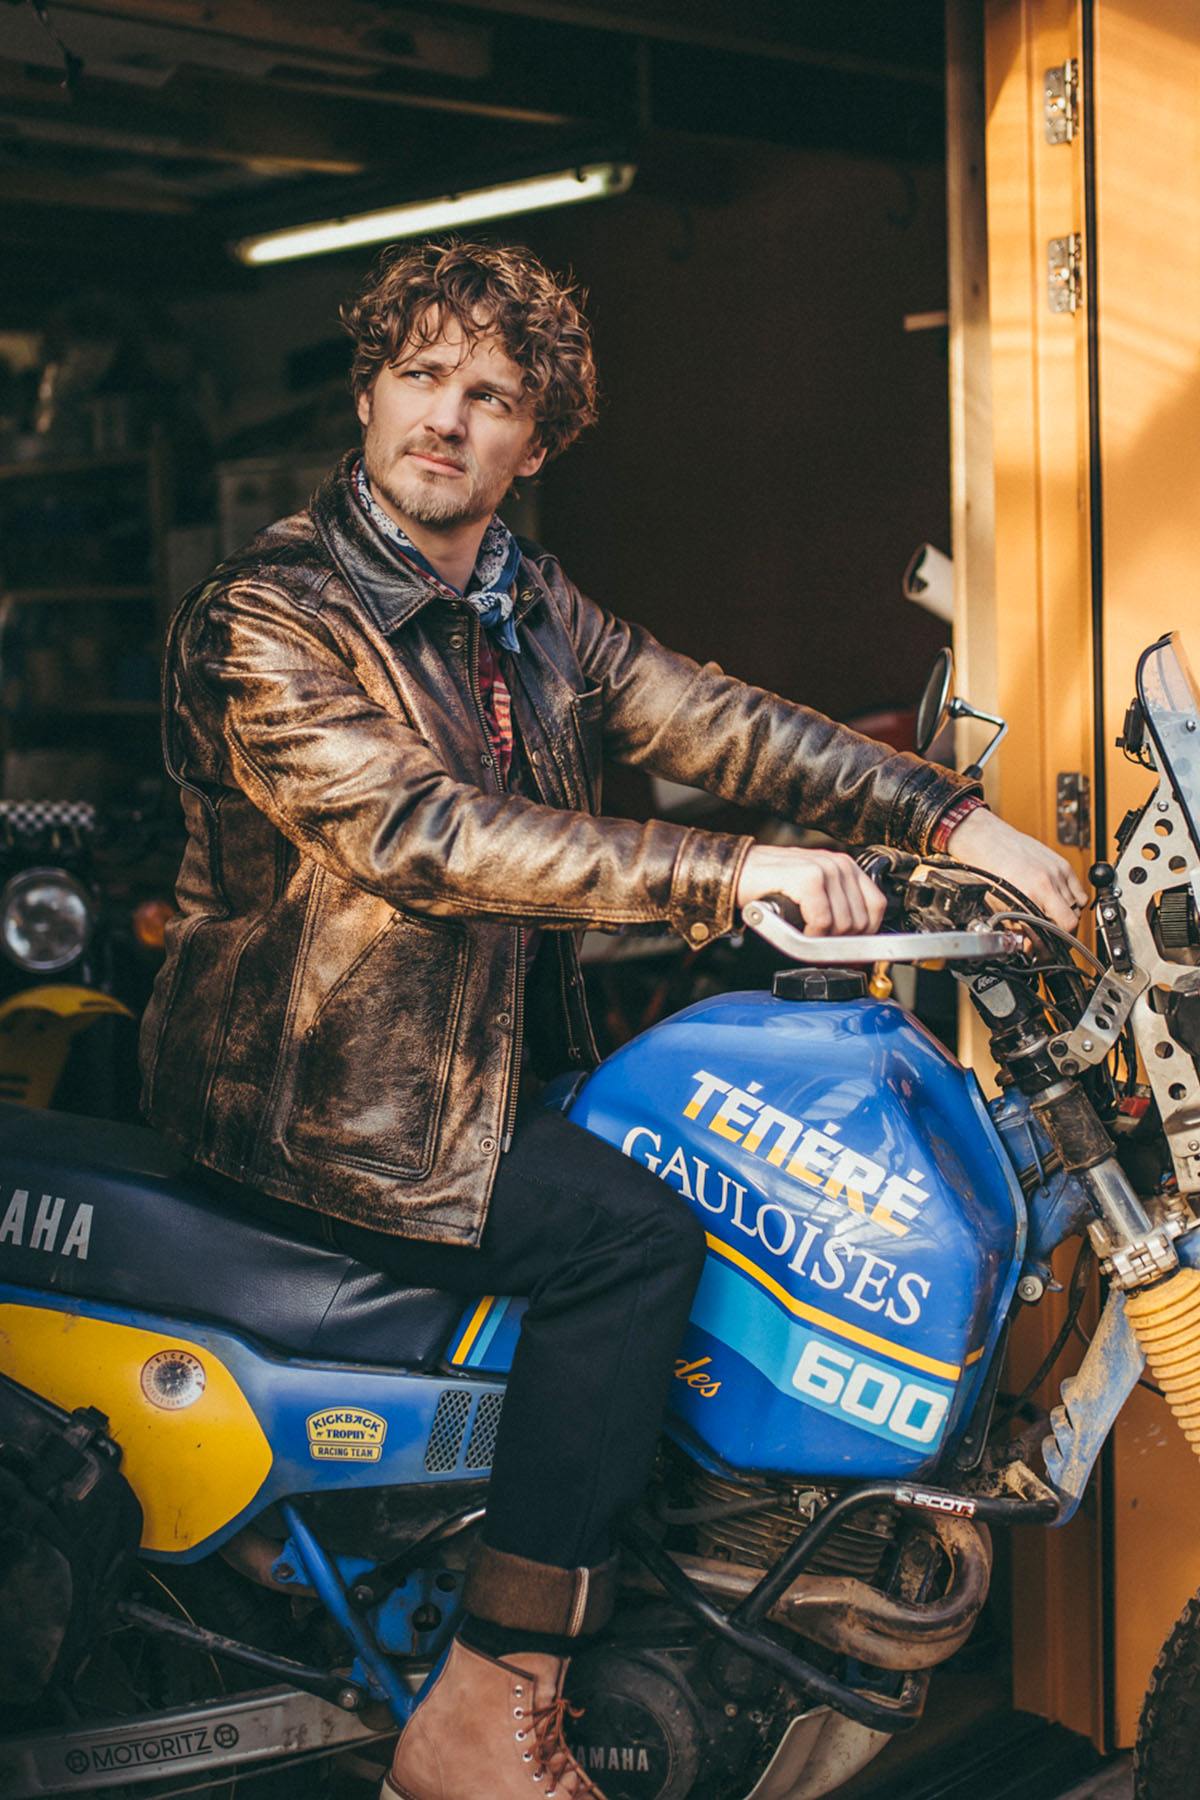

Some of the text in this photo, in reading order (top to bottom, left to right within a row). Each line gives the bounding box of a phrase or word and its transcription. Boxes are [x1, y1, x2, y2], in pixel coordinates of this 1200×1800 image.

[683, 1069, 930, 1237] TÉNÉRÉ
[621, 1126, 931, 1326] GAULOISES
[792, 1340, 949, 1444] 600
[312, 1413, 381, 1432] KICKBACK
[326, 1429, 366, 1439] TROPHY
[318, 1447, 373, 1456] RACING TEAM
[93, 1731, 211, 1768] MOTORITZ
[569, 1743, 649, 1772] AMAHA
